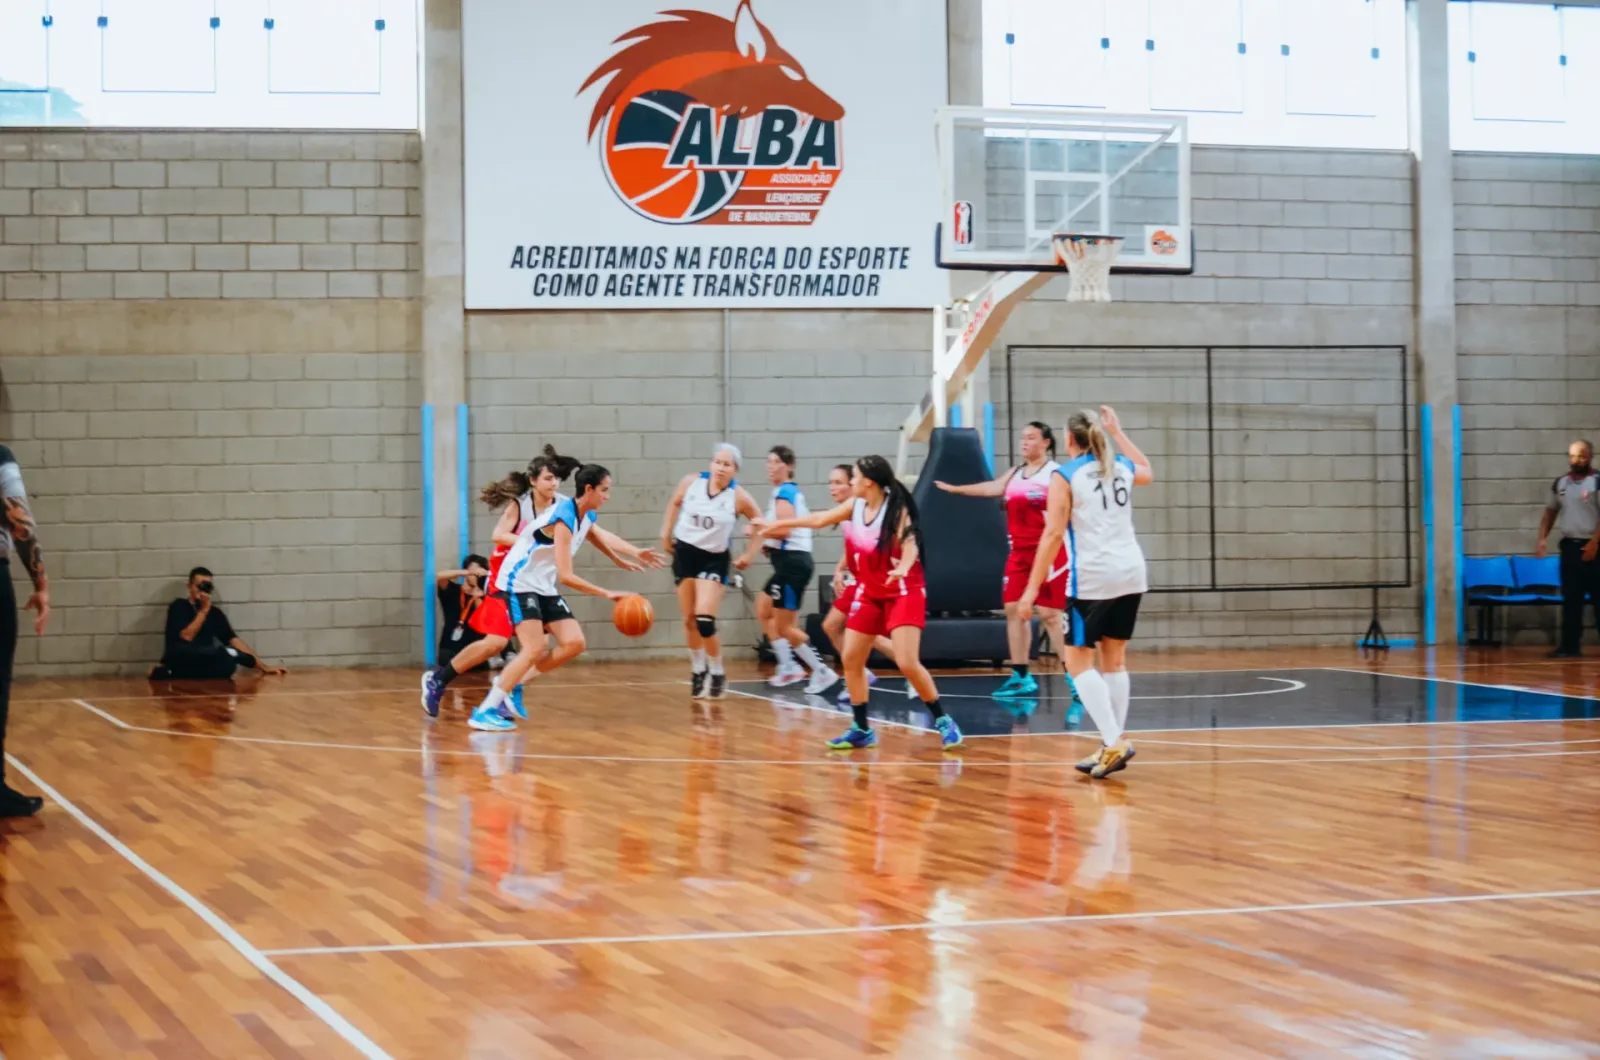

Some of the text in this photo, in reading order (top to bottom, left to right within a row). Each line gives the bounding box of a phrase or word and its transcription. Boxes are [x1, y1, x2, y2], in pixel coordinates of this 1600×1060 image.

[667, 105, 839, 168] ALBA
[728, 211, 744, 222] DE
[510, 245, 668, 269] ACREDITAMOS
[673, 246, 701, 269] NA
[783, 246, 812, 269] DO
[818, 246, 910, 269] ESPORTE
[533, 273, 880, 297] COMO AGENTE TRANSFORMADOR
[1093, 476, 1128, 510] 16
[691, 514, 714, 530] 10
